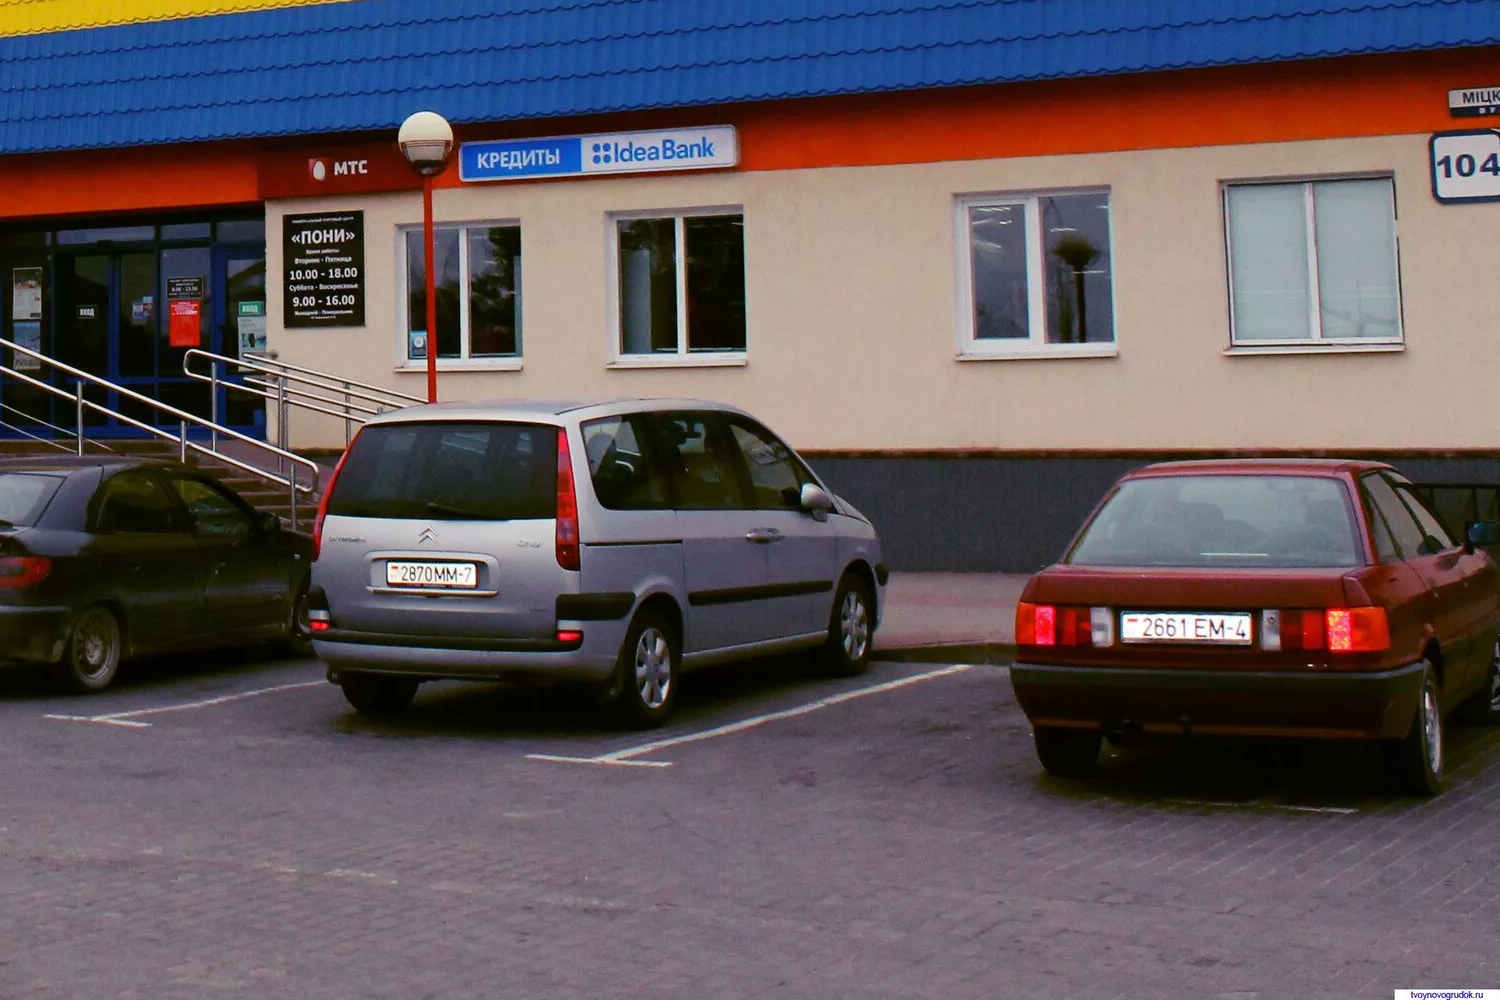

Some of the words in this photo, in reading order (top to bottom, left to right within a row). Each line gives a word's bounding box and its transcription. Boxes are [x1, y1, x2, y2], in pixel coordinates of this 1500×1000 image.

[477, 148, 560, 169] КРЕДИТЫ
[1437, 153, 1500, 178] 104
[334, 160, 368, 175] МТС
[291, 229, 356, 245] «ПОНИ»
[290, 270, 318, 280] 10.00
[329, 268, 358, 279] 18.00
[292, 297, 315, 307] 9.00
[326, 295, 355, 306] 16.00
[1143, 617, 1186, 637] 2661
[1195, 618, 1246, 638] EM-4
